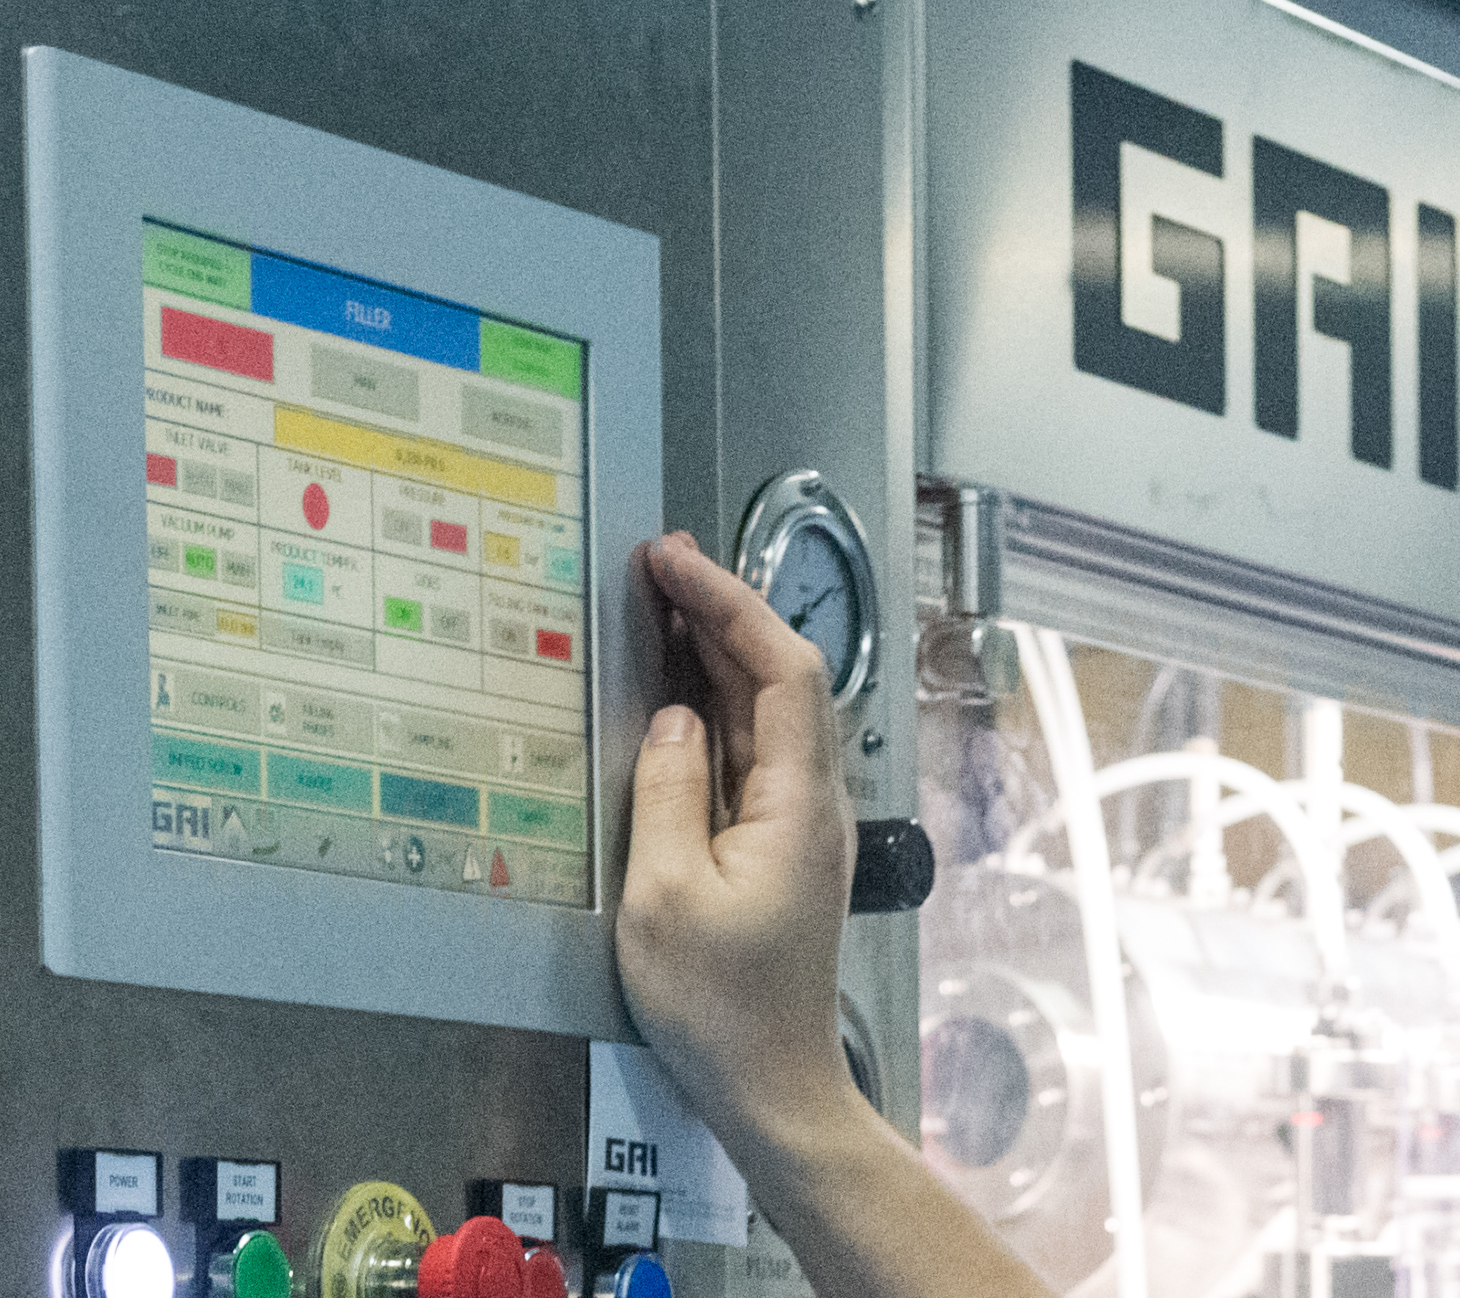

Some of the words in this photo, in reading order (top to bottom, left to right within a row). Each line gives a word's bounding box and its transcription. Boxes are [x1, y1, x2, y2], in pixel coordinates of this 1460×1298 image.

[1070, 57, 1460, 494] GAI
[345, 298, 391, 332] FILLER
[153, 799, 209, 839] GAI
[604, 1137, 658, 1177] GAI
[108, 1174, 139, 1189] POWER
[225, 1192, 264, 1207] ROTATION
[233, 1174, 257, 1188] START
[339, 1195, 437, 1262] EMERGENC
